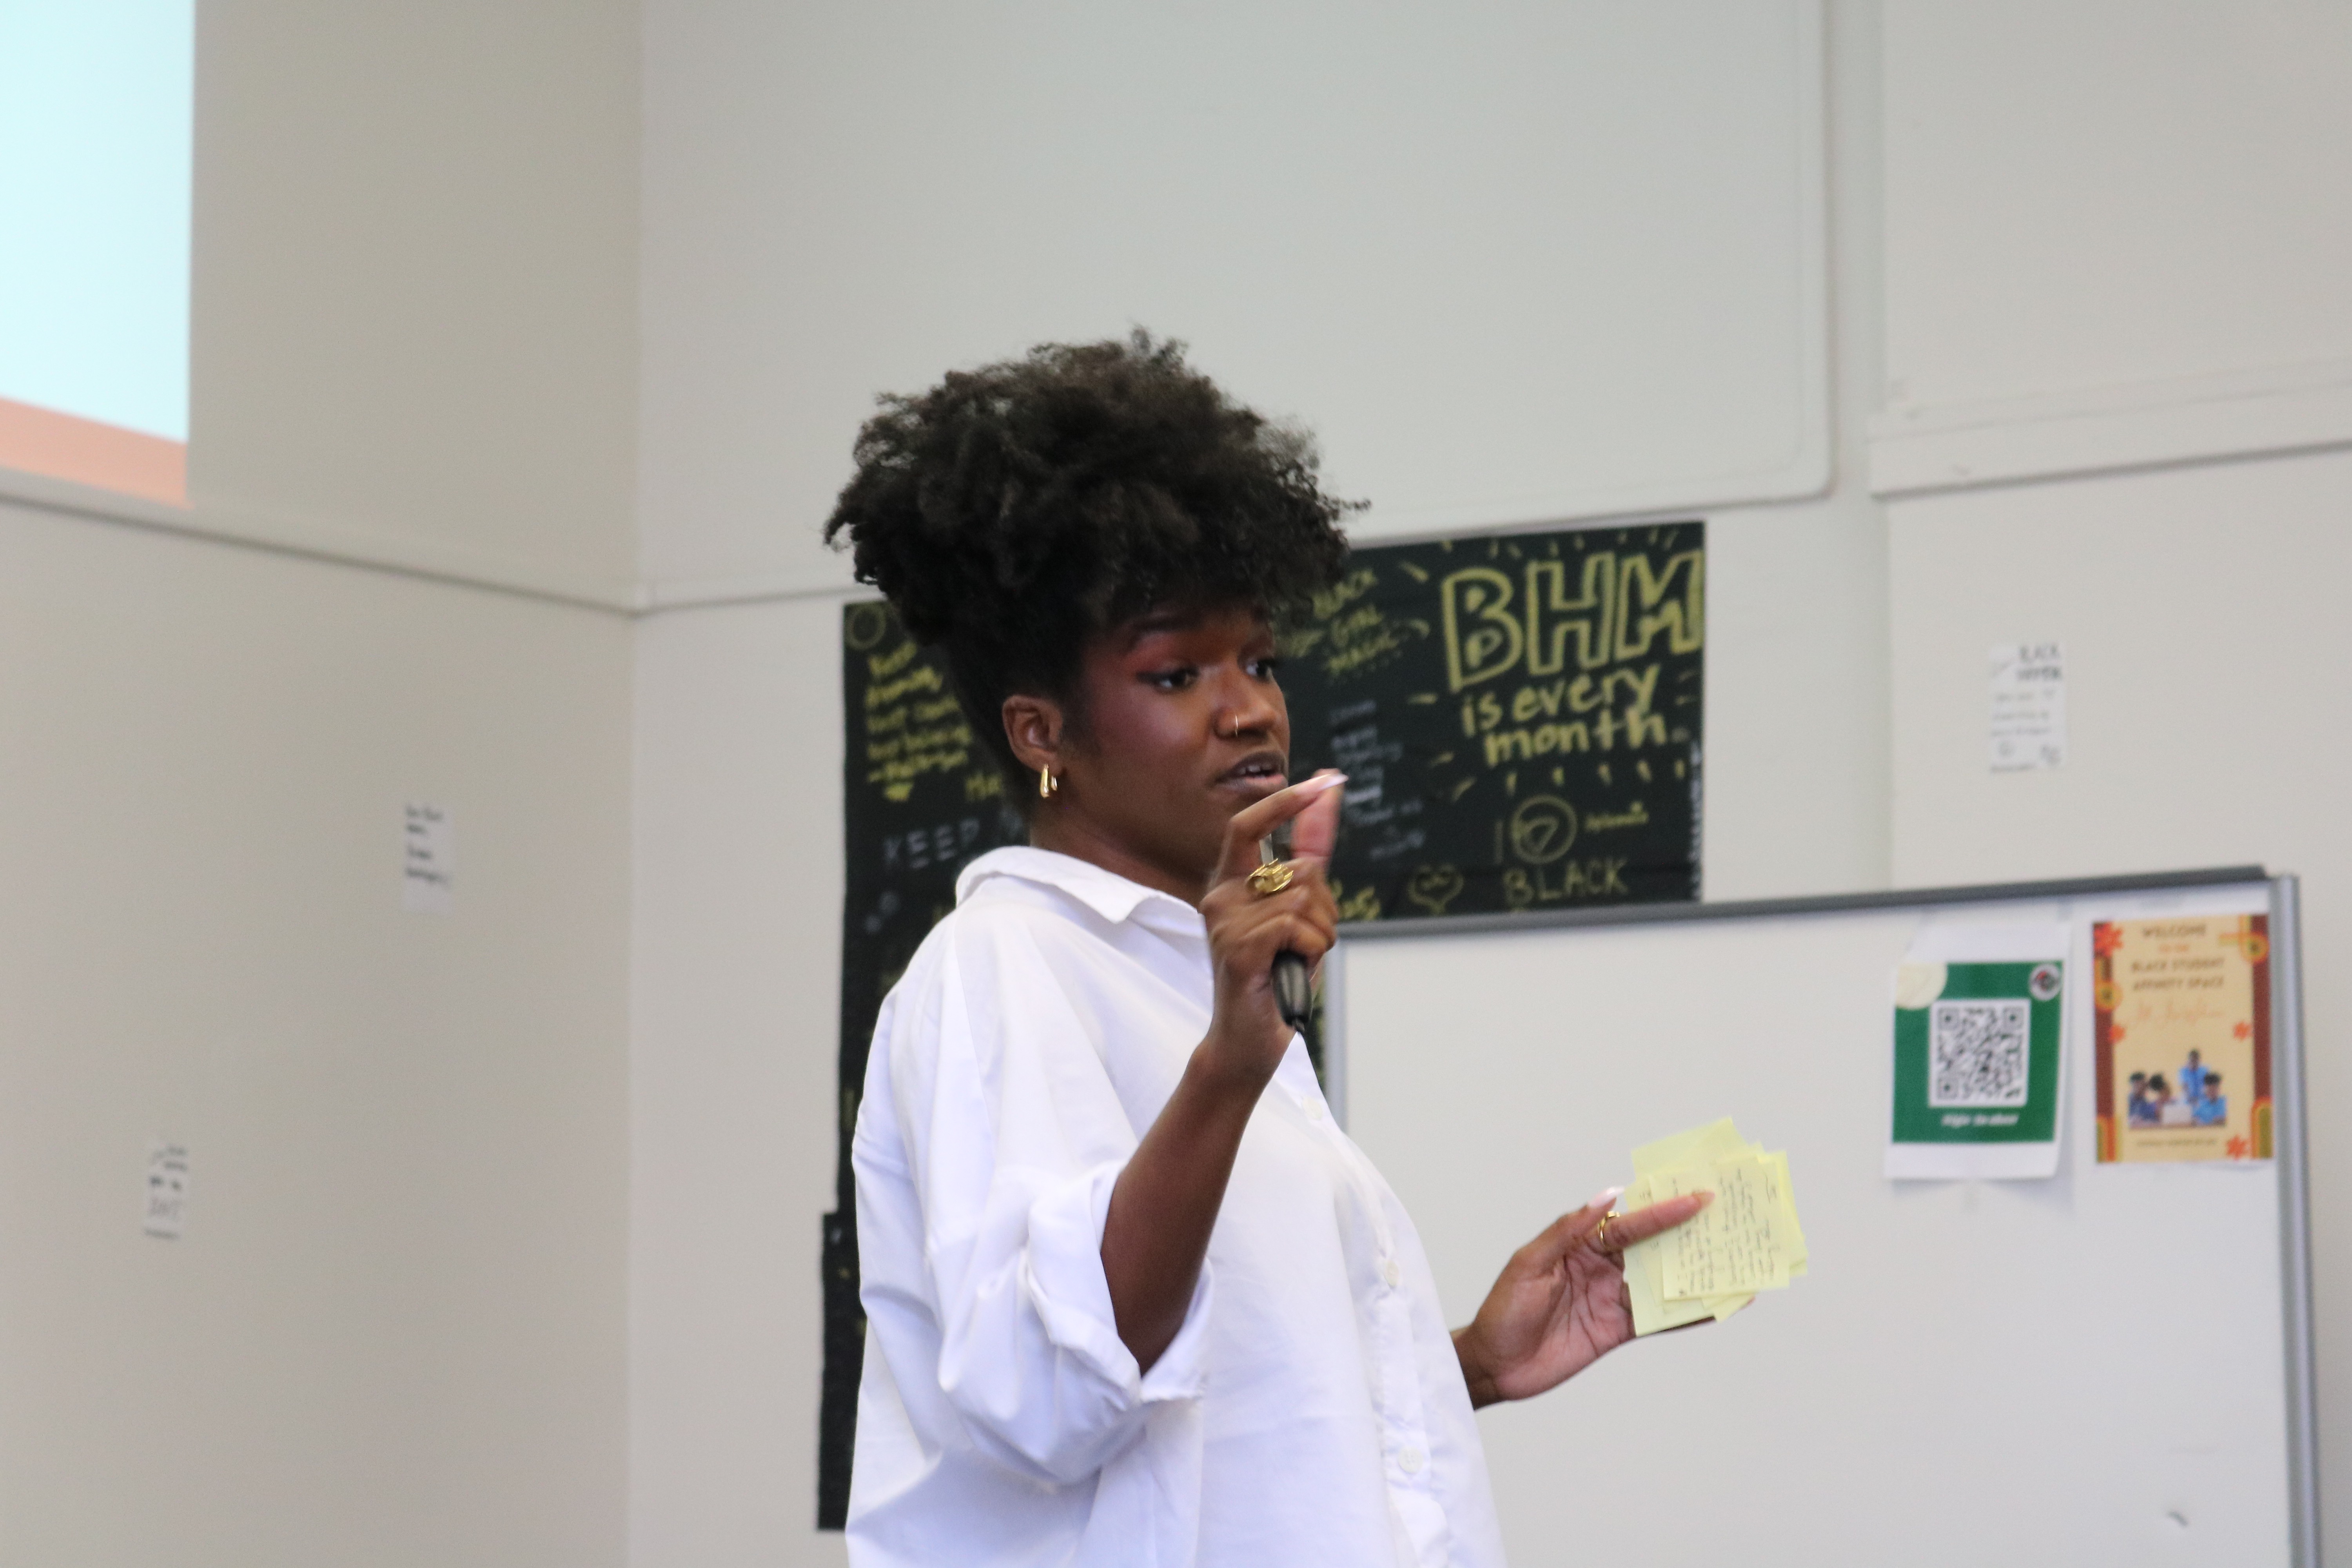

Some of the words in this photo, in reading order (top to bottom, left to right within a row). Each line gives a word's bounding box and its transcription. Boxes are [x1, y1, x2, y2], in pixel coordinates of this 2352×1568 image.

[1441, 548, 1704, 694] BHM
[1461, 692, 1502, 737] is
[1512, 663, 1661, 722] every
[1503, 858, 1630, 905] BLACK
